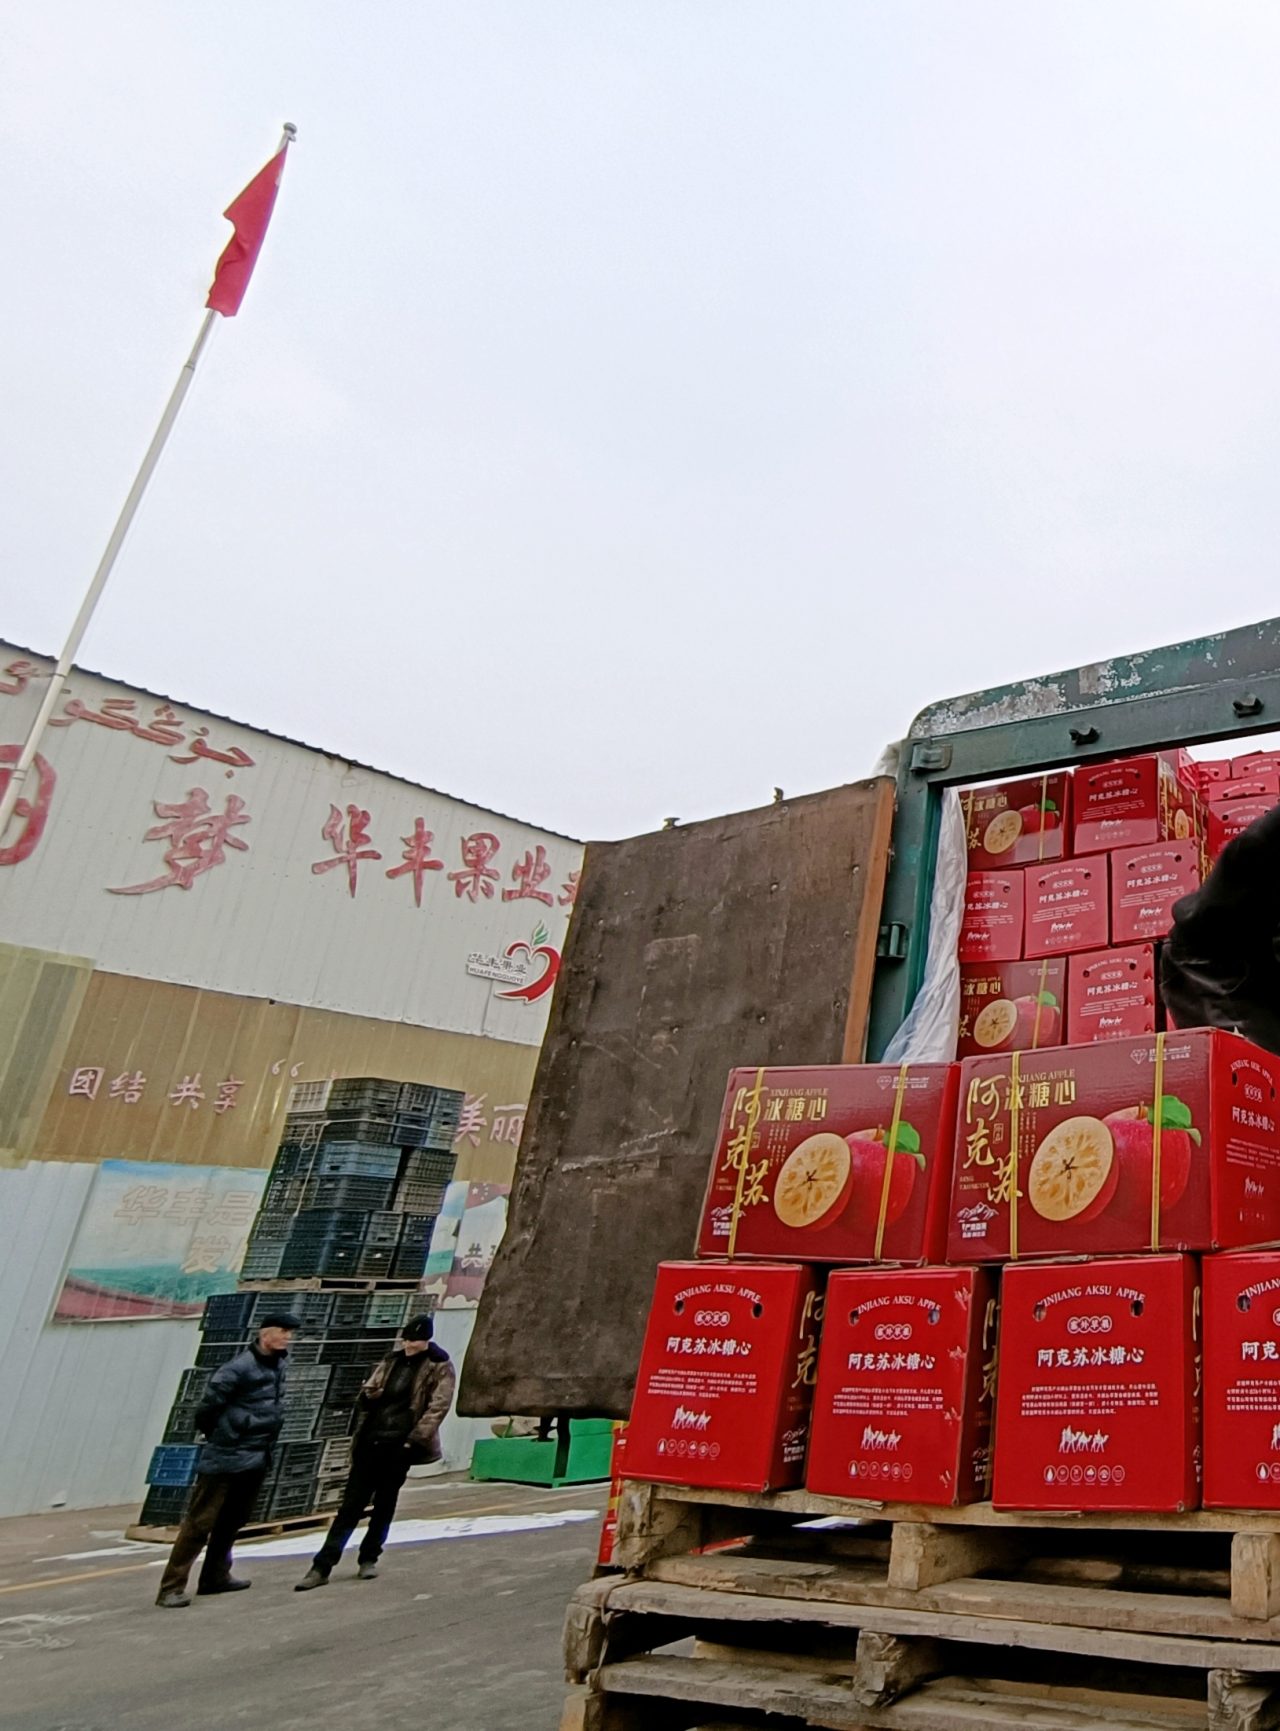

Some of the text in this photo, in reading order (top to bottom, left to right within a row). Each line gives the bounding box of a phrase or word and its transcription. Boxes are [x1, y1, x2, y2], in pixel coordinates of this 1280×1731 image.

[69, 1066, 245, 1115] 团结 共享
[1004, 1079, 1076, 1111] 冰糖心
[763, 1097, 828, 1122] 冰糖心
[454, 1093, 526, 1148] 美丽
[713, 1283, 735, 1294] AKSU
[737, 1286, 762, 1304] APPLE
[1085, 1284, 1112, 1296] AKSU
[1115, 1286, 1146, 1304] APPLE
[856, 1295, 890, 1314] INJIANG
[893, 1295, 915, 1305] AKSU
[666, 1336, 752, 1357] 阿克苏冰糖心
[1037, 1346, 1144, 1368] 阿克苏冰糖心
[848, 1352, 936, 1371] 阿克苏冰糖心
